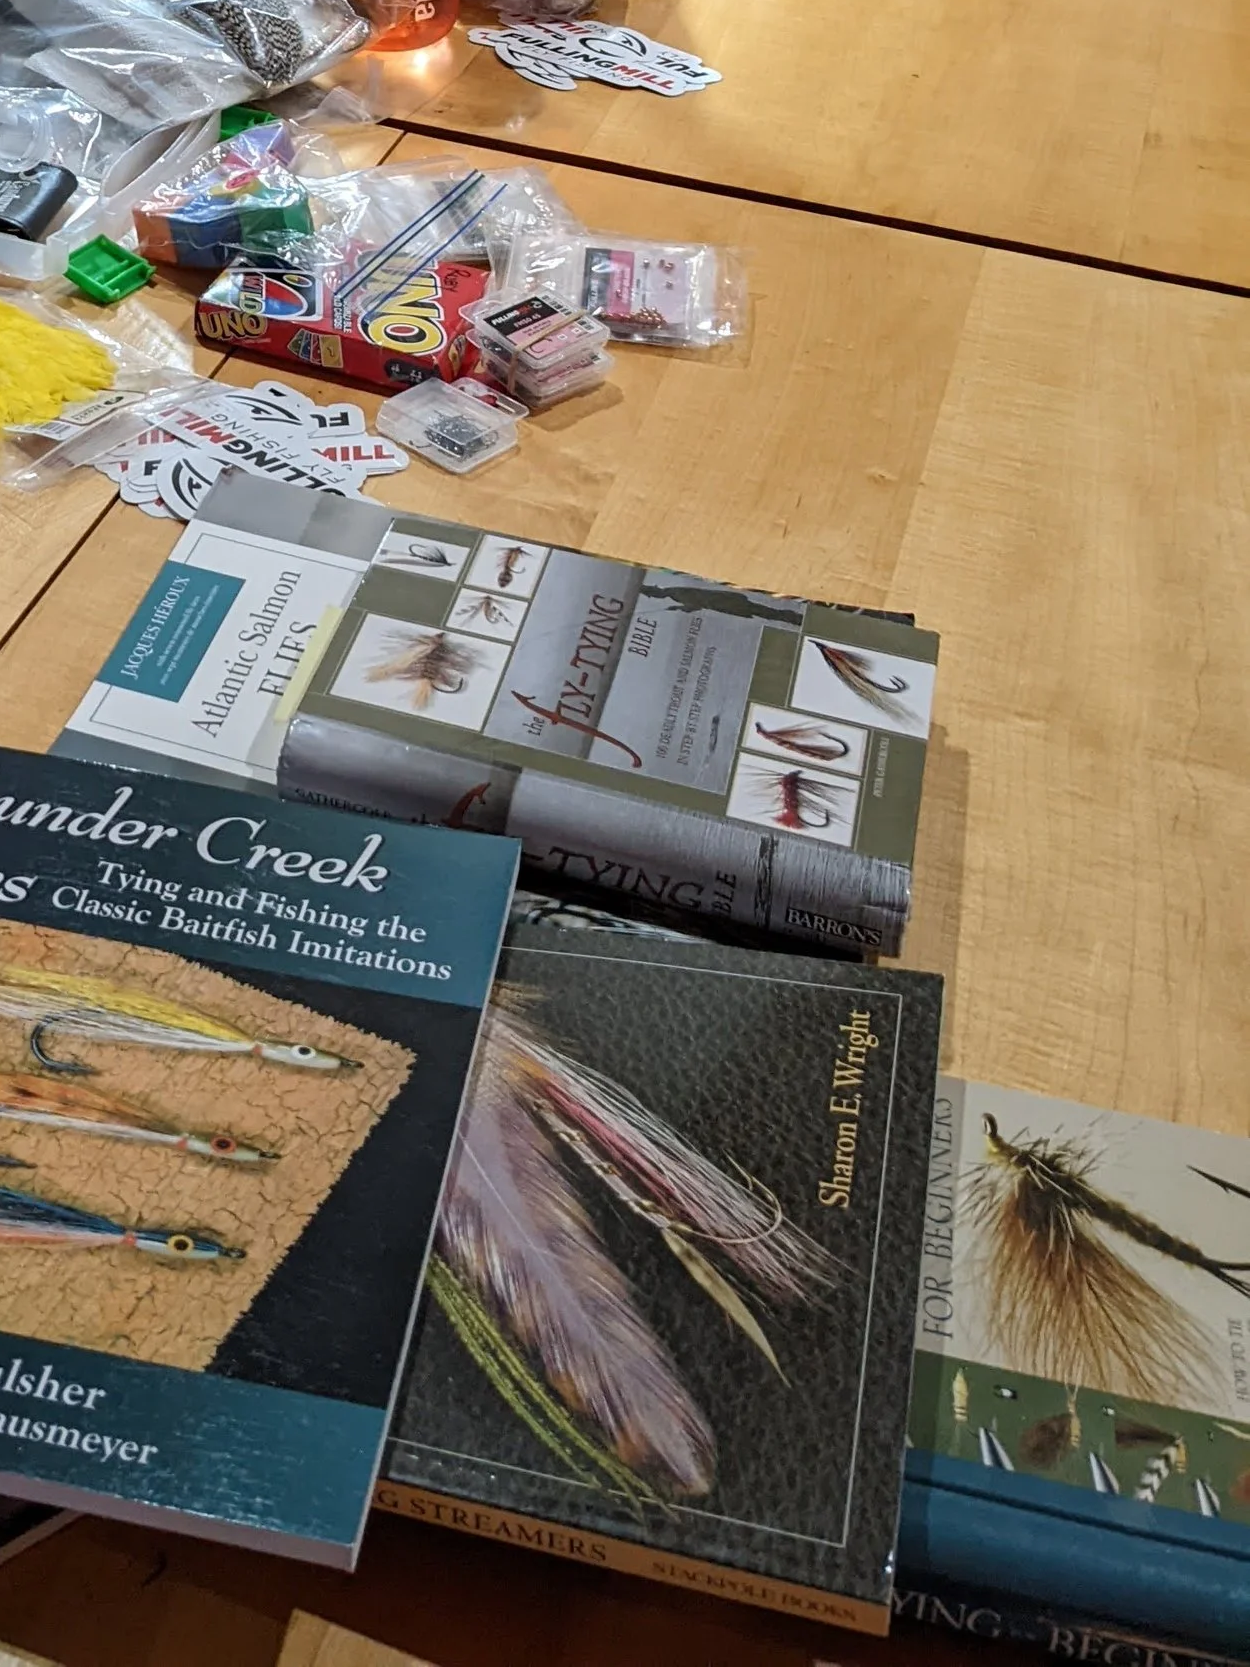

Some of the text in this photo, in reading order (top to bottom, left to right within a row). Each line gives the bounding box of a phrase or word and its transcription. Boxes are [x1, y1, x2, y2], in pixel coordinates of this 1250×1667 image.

[198, 312, 268, 340] UNO
[239, 274, 265, 315] WILD
[120, 624, 159, 680] JACQUES
[154, 575, 191, 625] HÉROUX
[191, 570, 302, 738] Atlantic Salmon
[628, 616, 658, 658] BIBLE
[196, 816, 391, 894] Creek
[51, 885, 453, 982] Classic Baitfish Imitations
[97, 859, 427, 945] Tying and Fishing the
[786, 908, 883, 947] BARRON'S
[817, 1008, 880, 1210] Sharon E. Wright
[922, 1097, 954, 1340] FOR BEGINNERS
[408, 1496, 609, 1563] STREAMERS
[651, 1559, 858, 1624] STACKPOLE BOOKS
[892, 1588, 1002, 1638] YING
